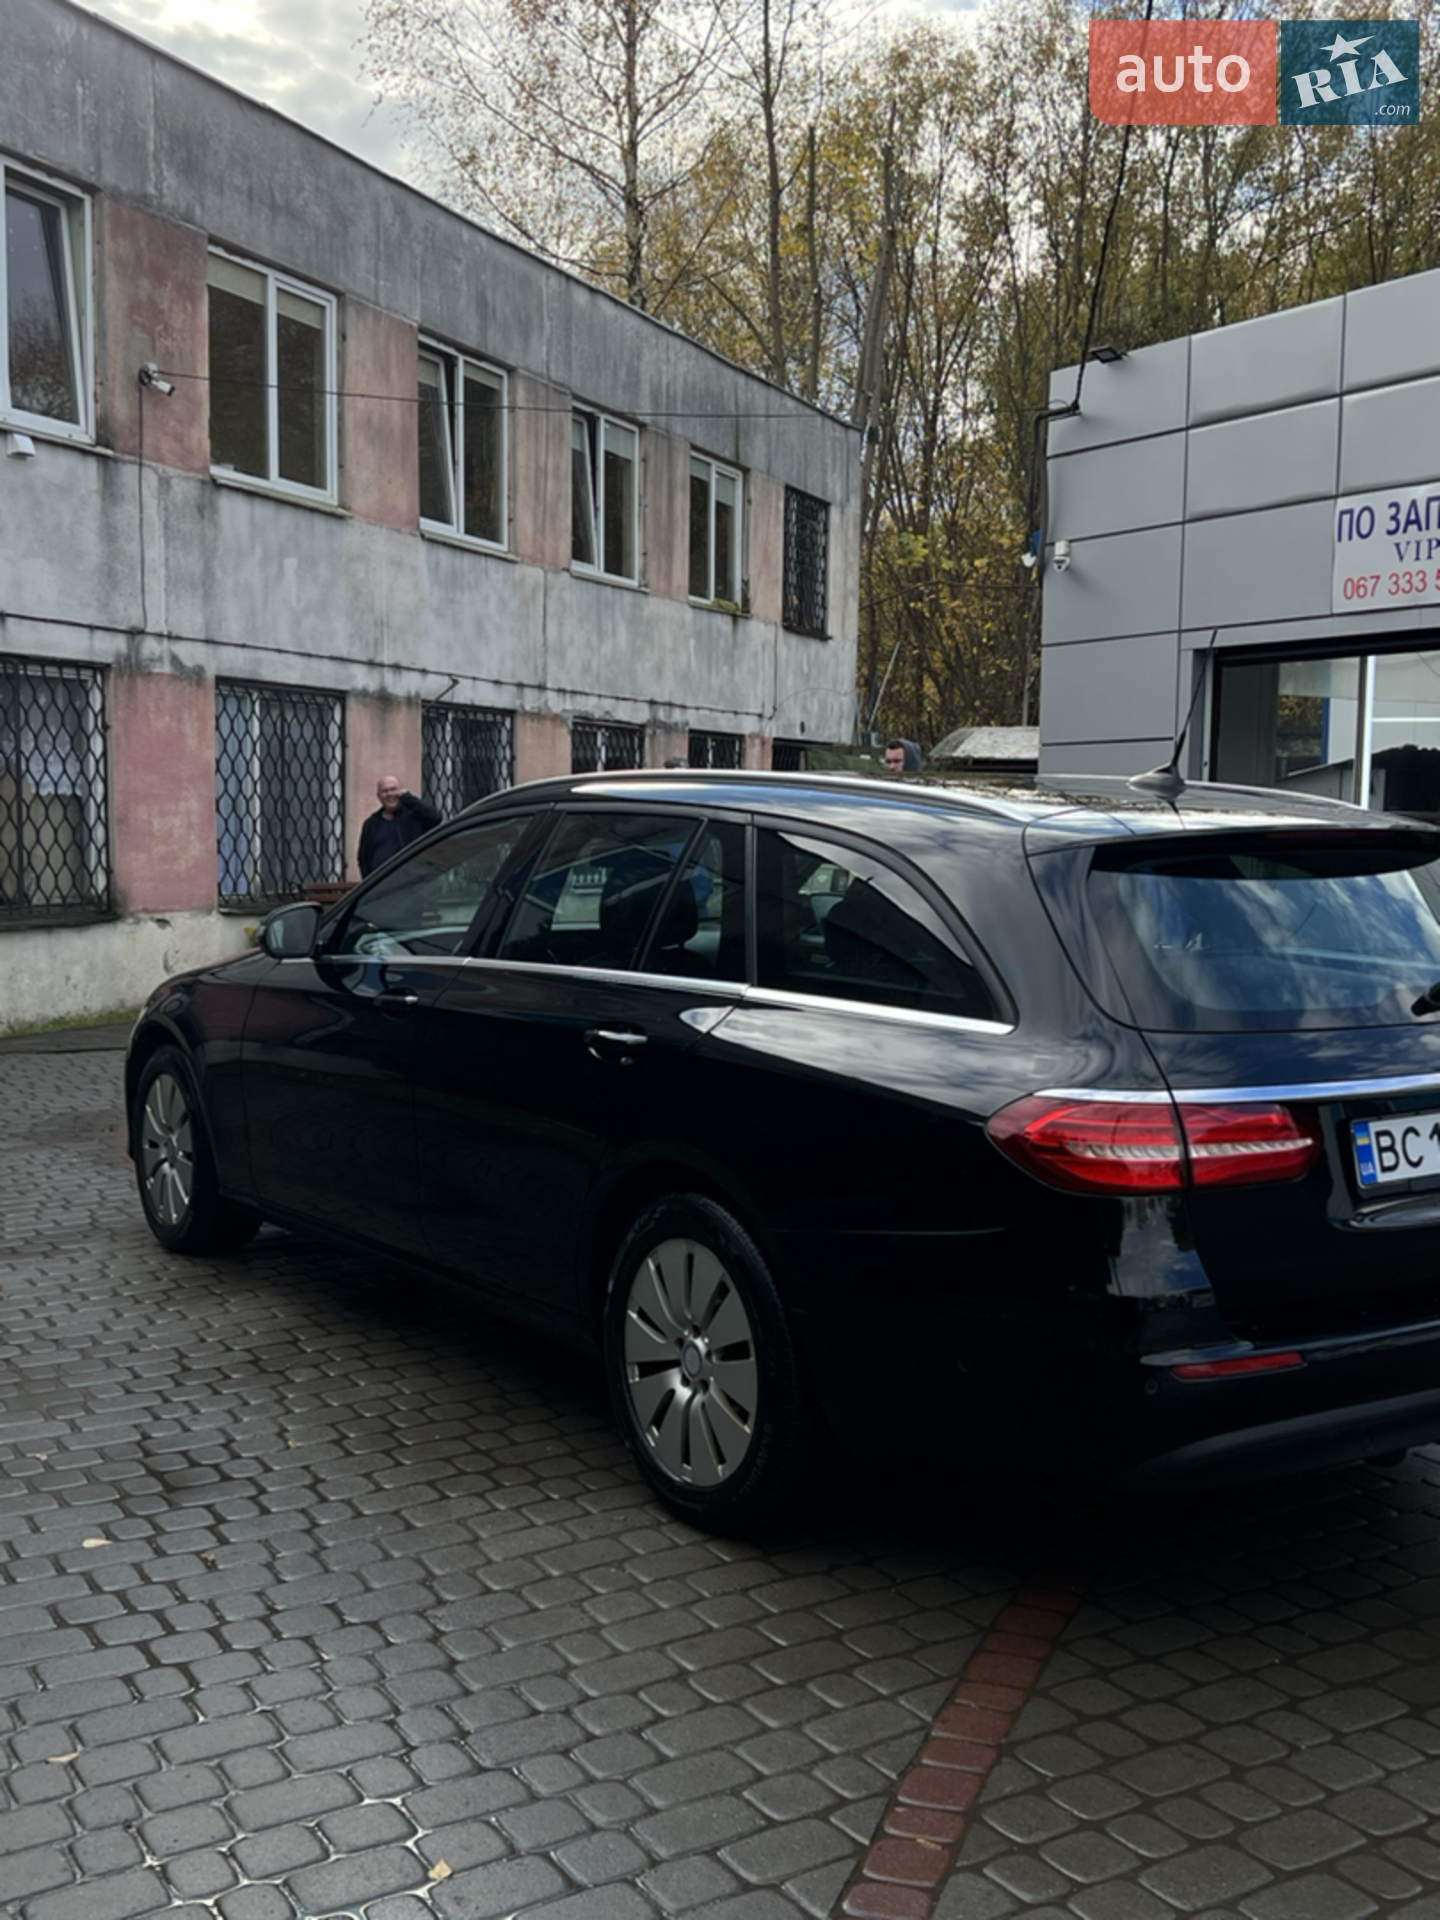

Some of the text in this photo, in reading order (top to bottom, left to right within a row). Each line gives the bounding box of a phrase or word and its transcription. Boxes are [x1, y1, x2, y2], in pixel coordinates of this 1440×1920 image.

[1337, 494, 1440, 543] ПО ЗАП
[1393, 537, 1440, 563] VIP
[1343, 574, 1381, 600] 067
[1387, 569, 1428, 596] 333
[1360, 1161, 1375, 1176] UA
